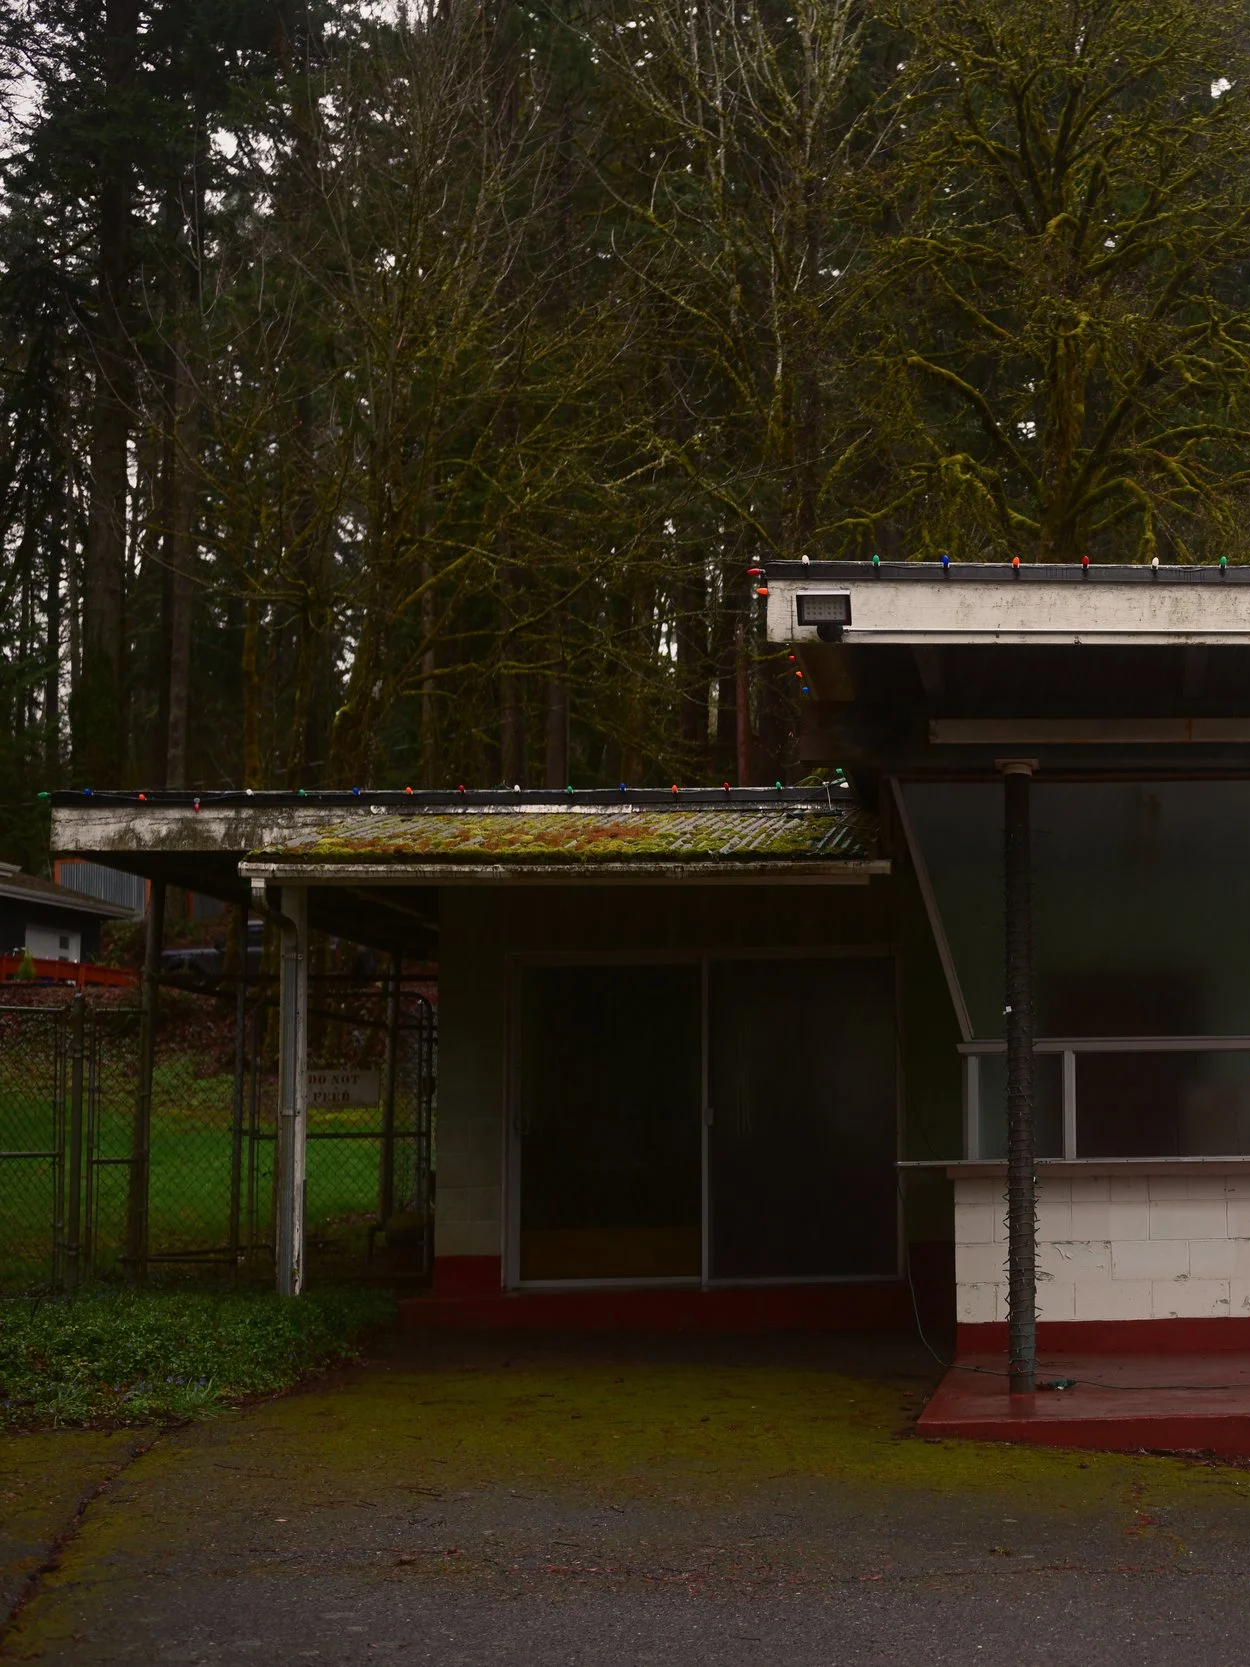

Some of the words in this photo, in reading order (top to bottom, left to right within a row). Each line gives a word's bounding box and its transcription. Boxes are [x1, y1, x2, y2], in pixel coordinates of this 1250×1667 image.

[308, 1075, 326, 1085] DO
[331, 1075, 360, 1085] NOT
[313, 1092, 350, 1102] FEED
